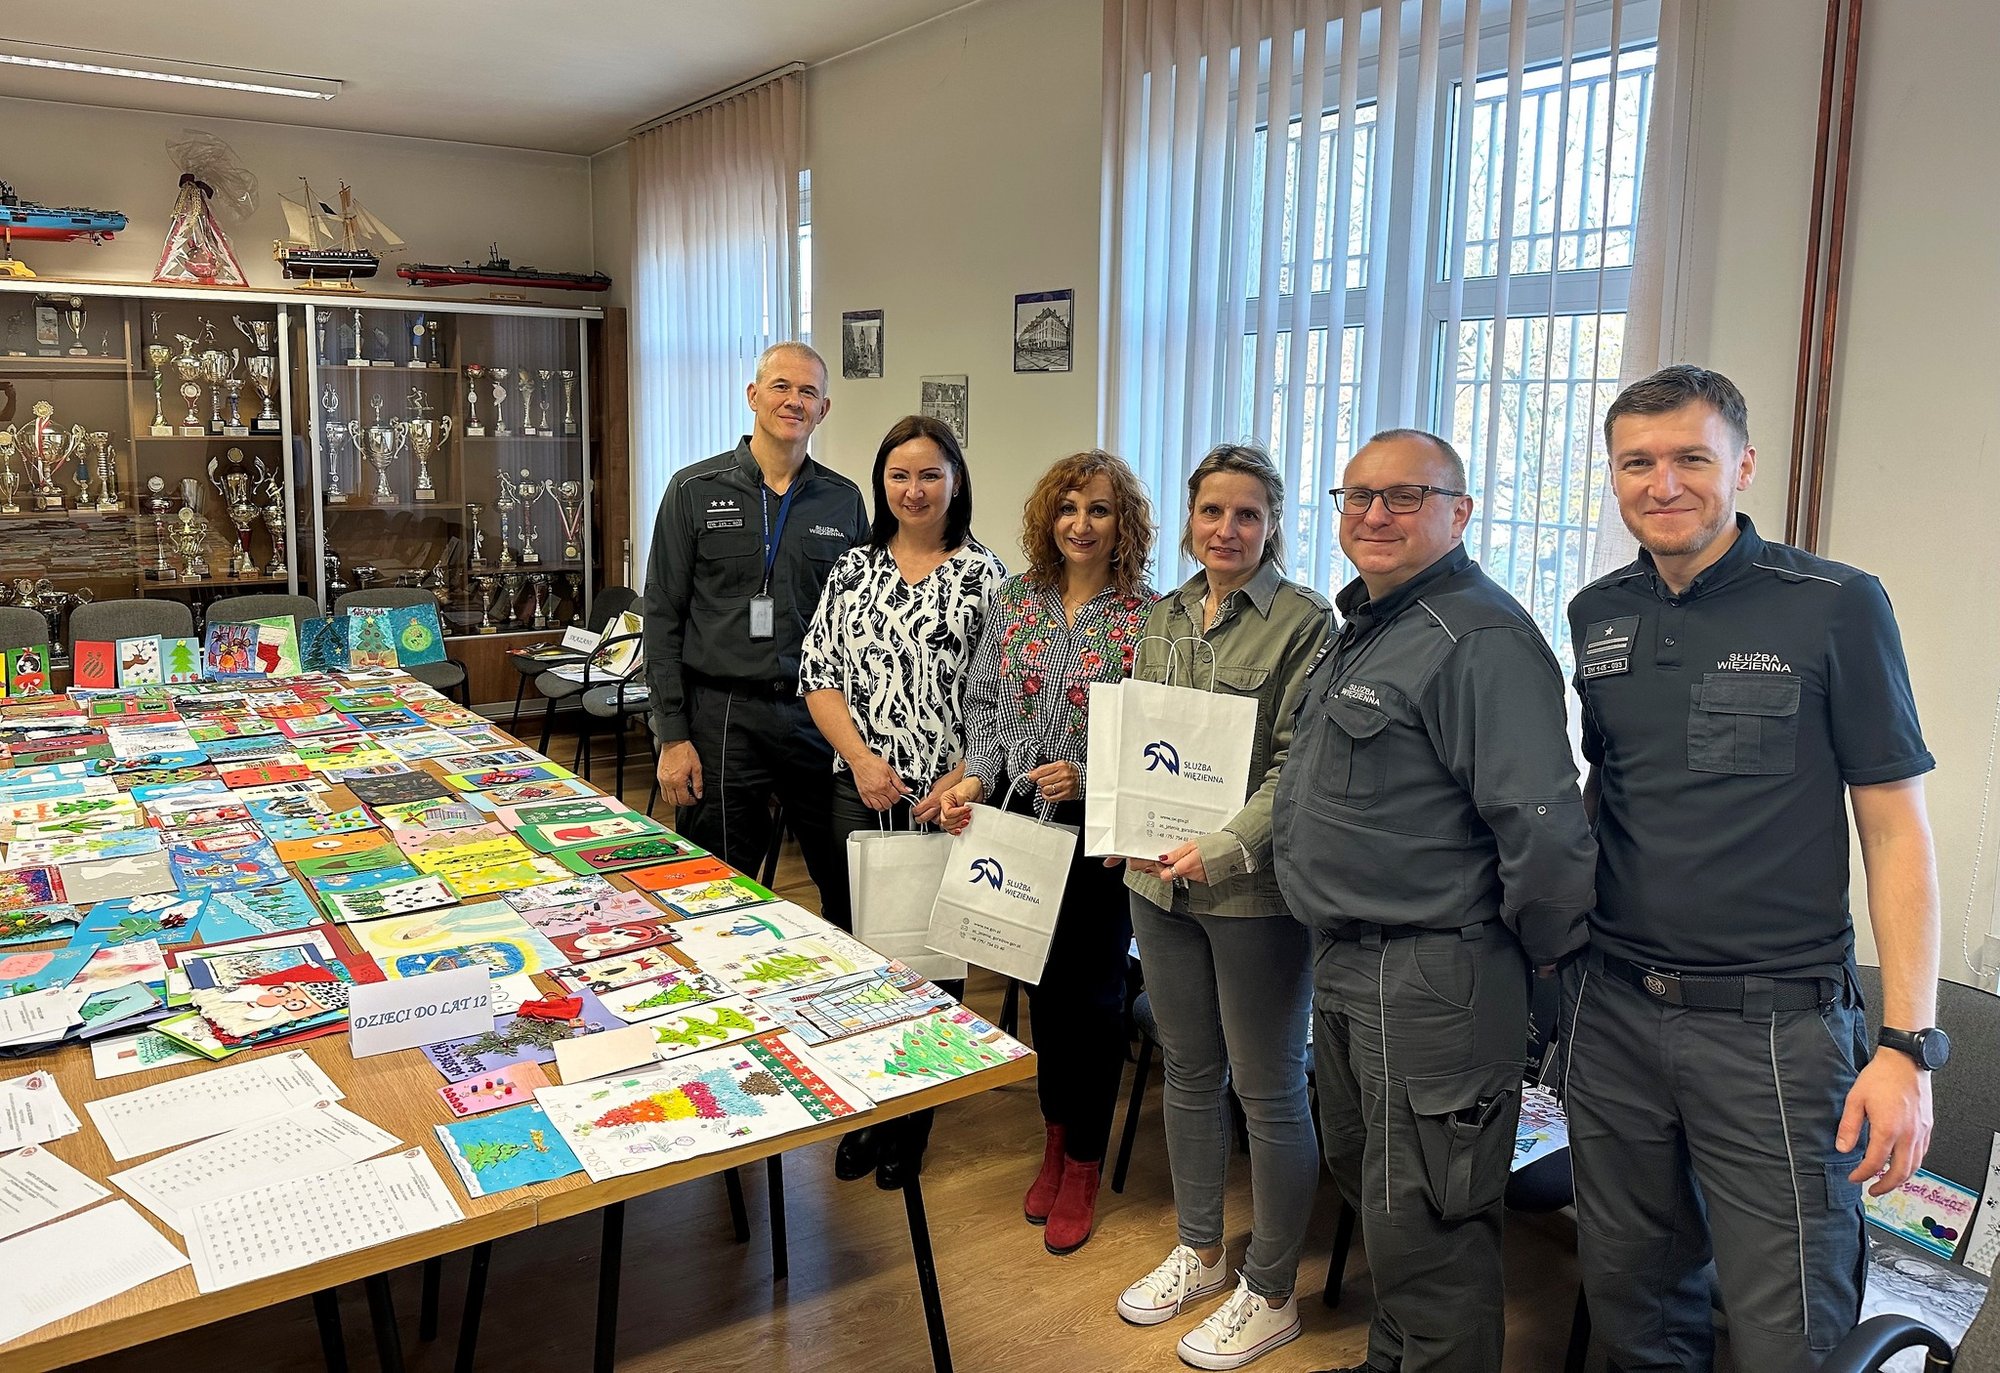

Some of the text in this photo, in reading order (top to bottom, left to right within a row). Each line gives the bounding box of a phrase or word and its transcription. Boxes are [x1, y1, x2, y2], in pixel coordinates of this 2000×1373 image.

[1728, 651, 1780, 663] SŁUŻBA
[1717, 661, 1792, 673] WIĘZIENNA
[1183, 760, 1212, 773] SŁUŻBA
[1183, 771, 1225, 784] WIĘZIENNA
[1004, 887, 1040, 905] WIĘZIENNA
[354, 995, 487, 1029] DZIECI DO LAT 12
